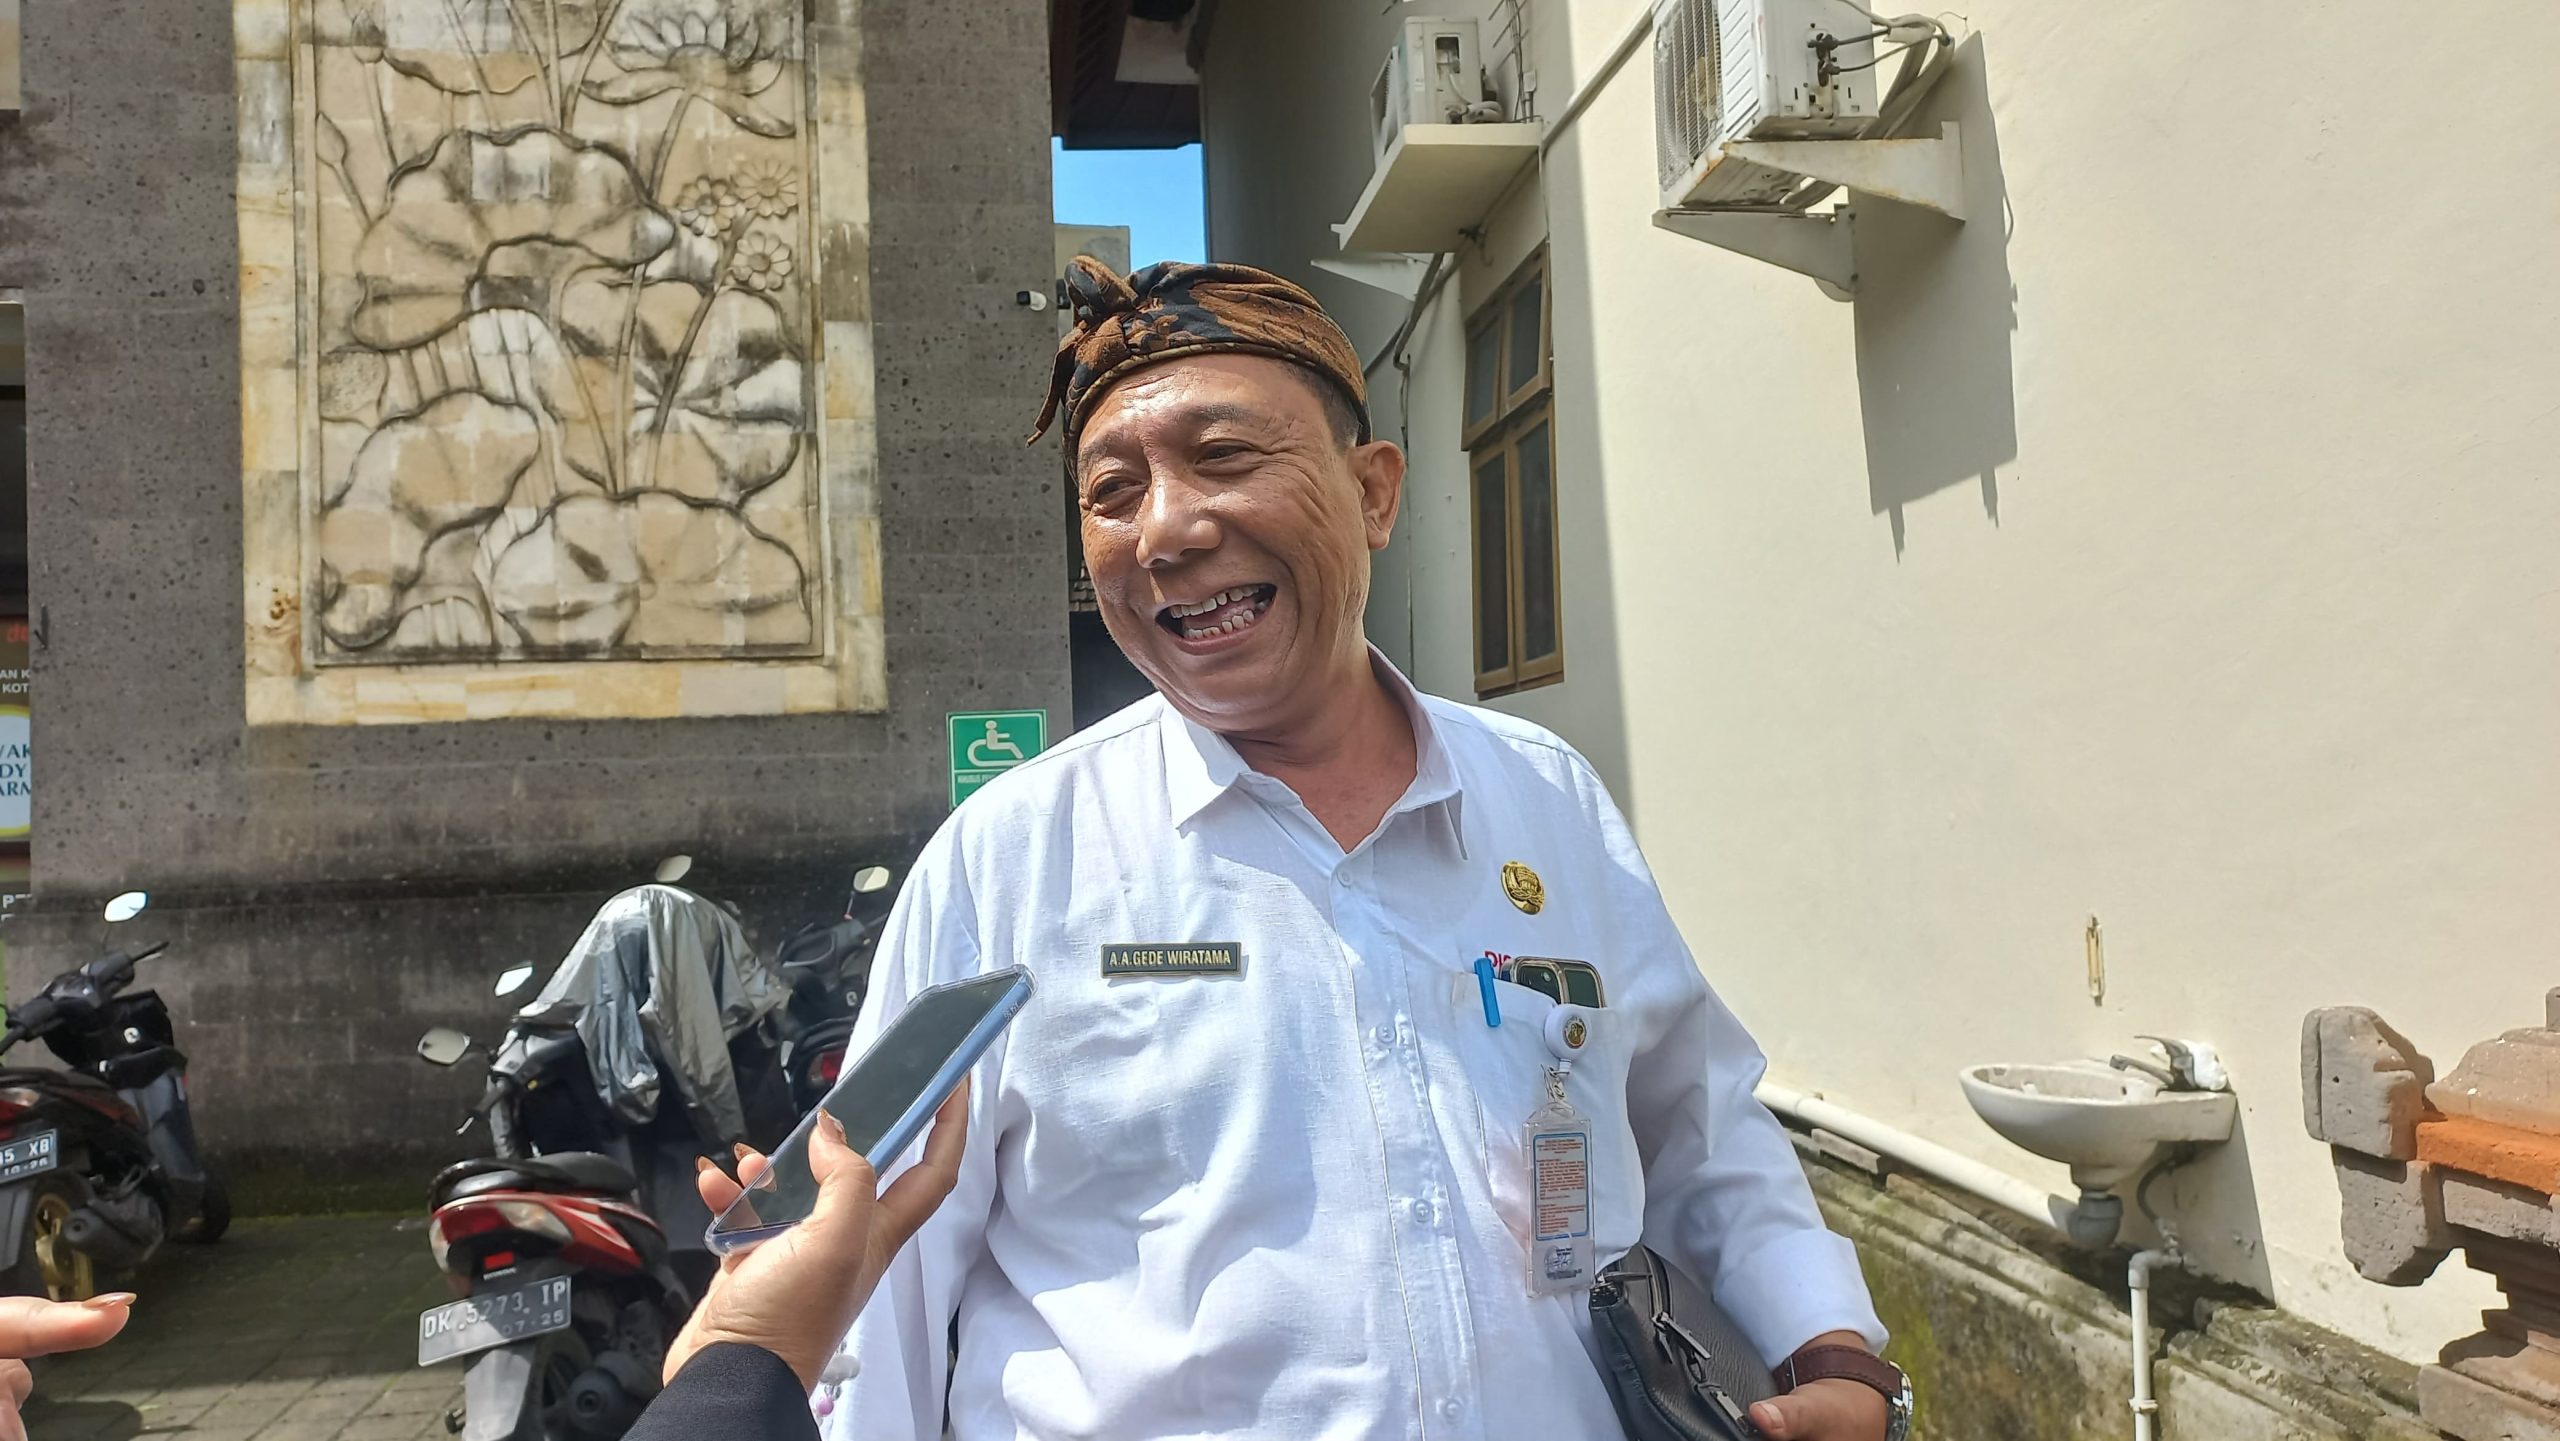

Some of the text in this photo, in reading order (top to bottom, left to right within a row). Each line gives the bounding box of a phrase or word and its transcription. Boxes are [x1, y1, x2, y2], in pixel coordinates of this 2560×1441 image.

[0, 744, 31, 759] AK
[1167, 949, 1231, 965] WIRATAMA
[424, 1310, 450, 1338] DK
[542, 1281, 566, 1305] IP
